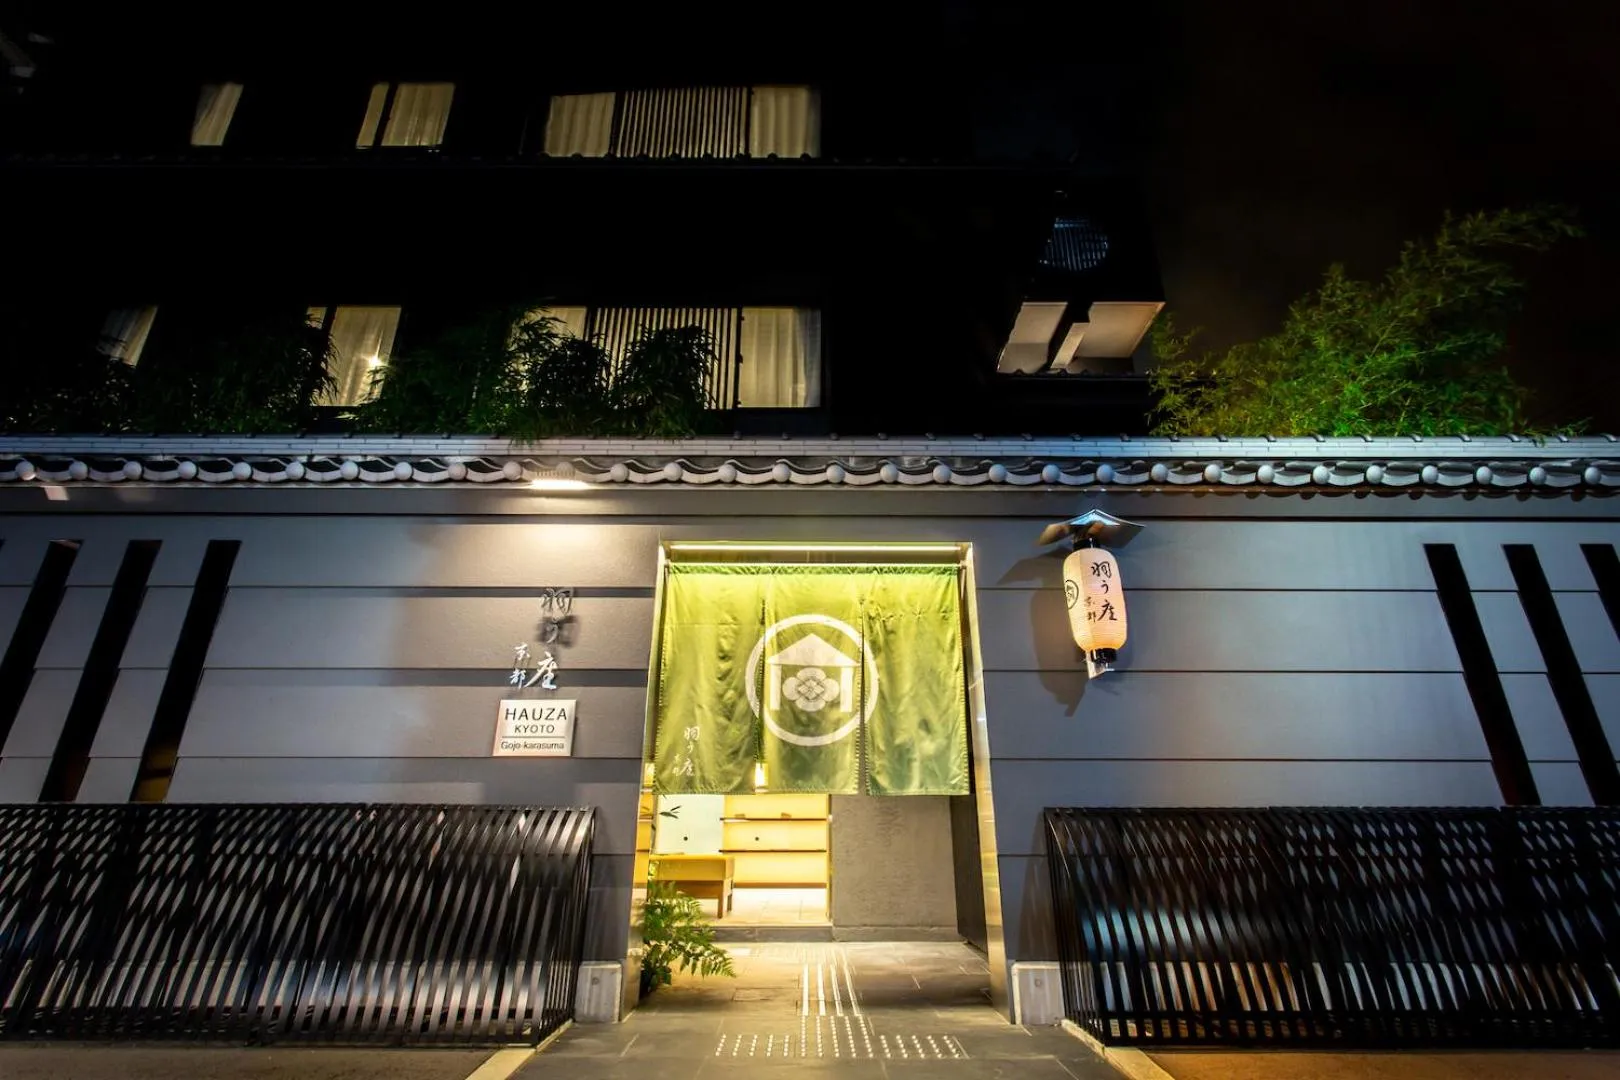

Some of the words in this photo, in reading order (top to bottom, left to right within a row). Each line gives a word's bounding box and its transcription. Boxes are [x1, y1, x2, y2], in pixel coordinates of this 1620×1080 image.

[504, 707, 567, 721] HAUZA
[514, 724, 555, 734] KYOTO
[501, 740, 565, 751] Gojo-karasuma
